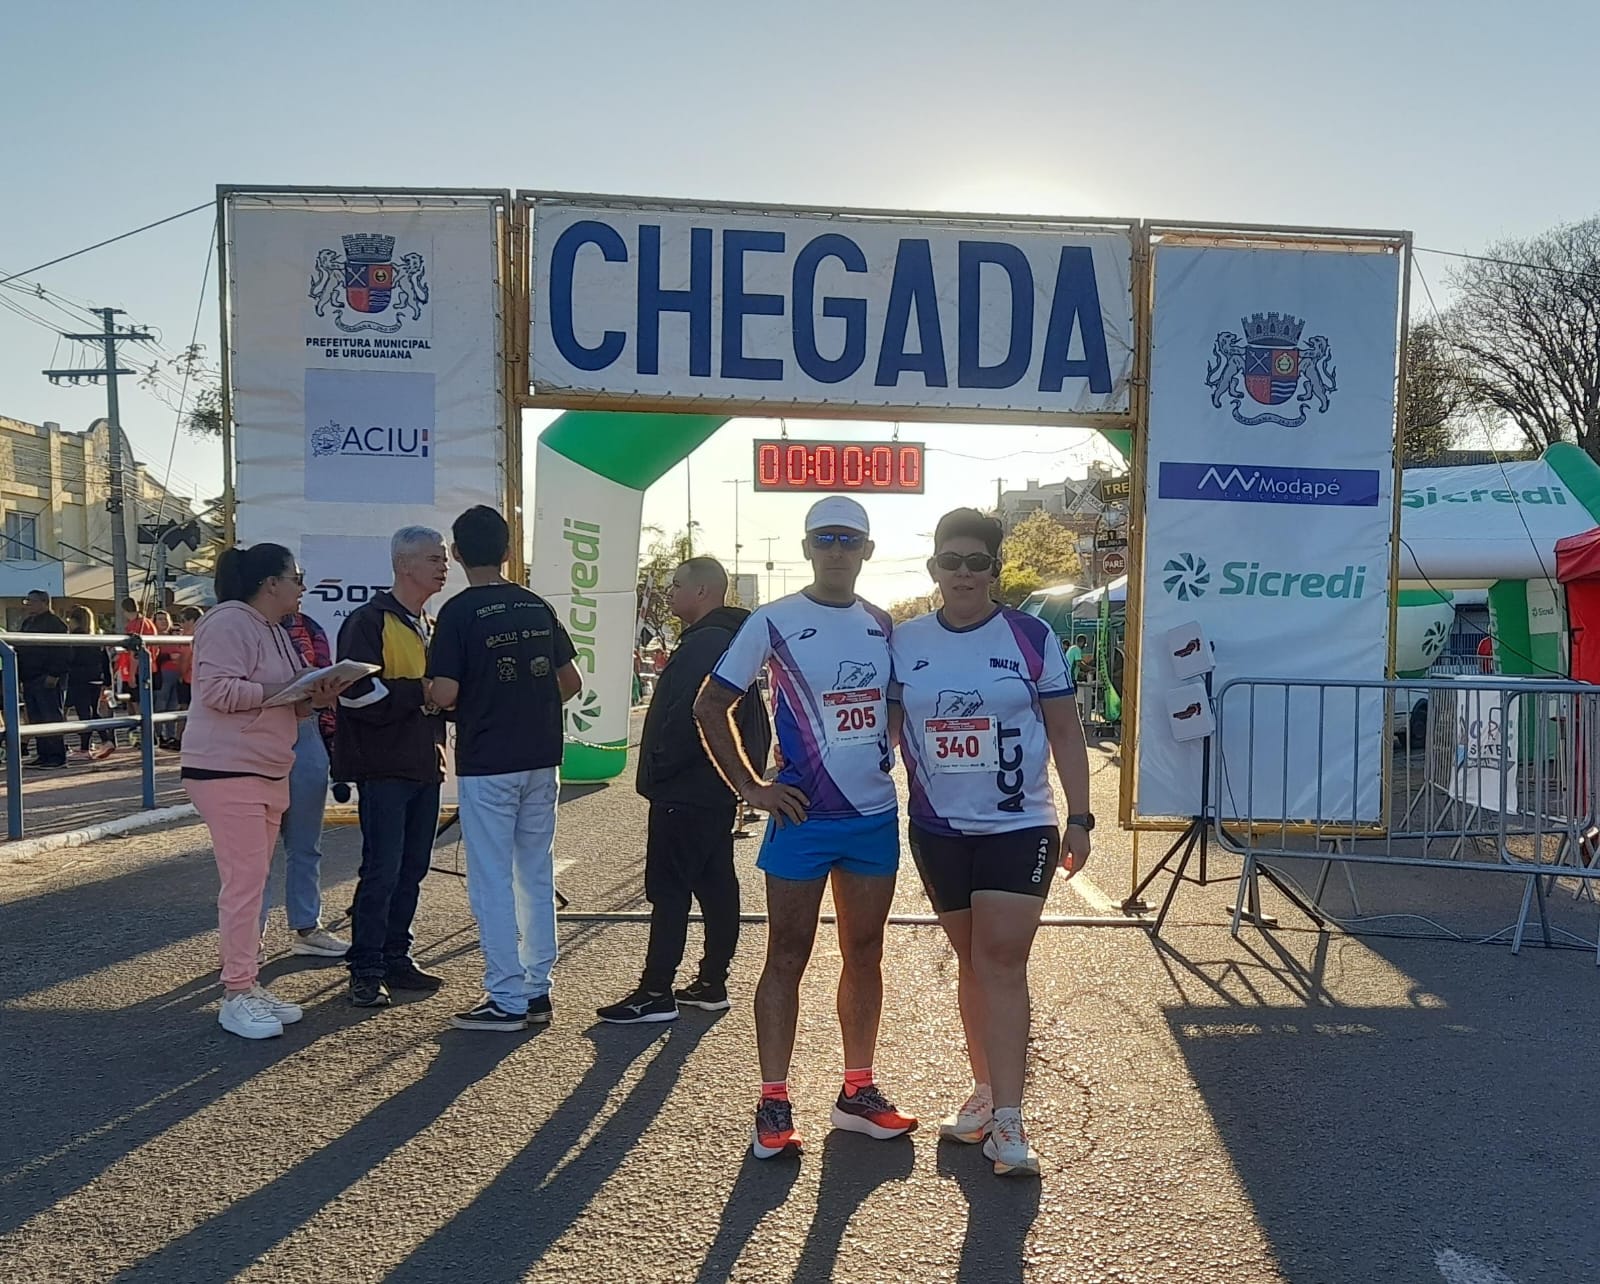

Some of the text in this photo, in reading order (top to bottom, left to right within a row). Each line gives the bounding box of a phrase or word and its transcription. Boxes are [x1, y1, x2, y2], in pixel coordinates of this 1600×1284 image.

[549, 220, 1113, 394] CHEGADA
[306, 338, 431, 349] PREFEITURA MUNICIPAL
[326, 349, 412, 359] DE URUGUAIANA
[759, 444, 919, 487] 00:00:00
[1258, 477, 1341, 498] Modapé
[1402, 487, 1567, 508] Sicredi
[1104, 560, 1124, 568] PARE
[1219, 561, 1366, 599] Sicredi
[836, 706, 876, 731] 205
[936, 736, 979, 758] 340
[997, 721, 1026, 813] ACCT
